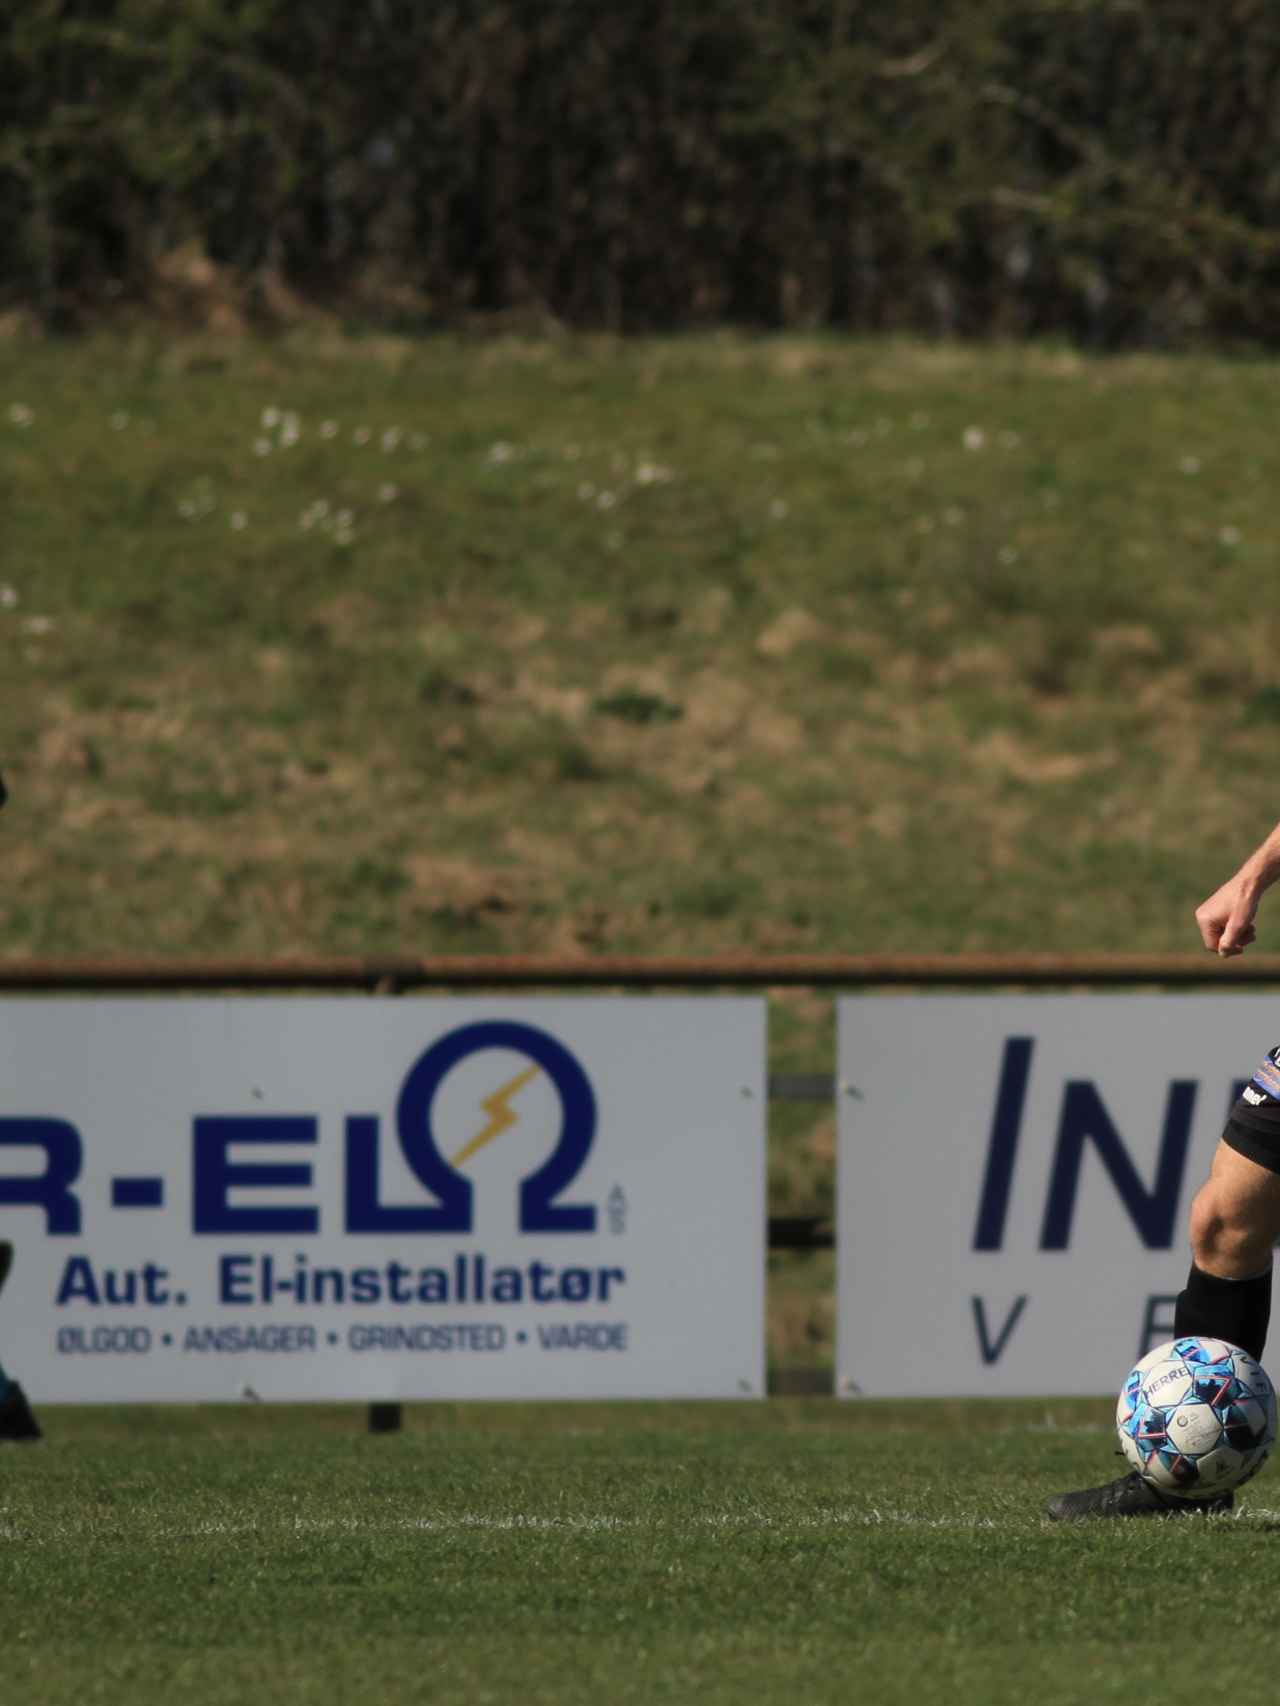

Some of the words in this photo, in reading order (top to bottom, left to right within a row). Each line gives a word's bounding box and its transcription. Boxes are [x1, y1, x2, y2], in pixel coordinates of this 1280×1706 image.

[56, 1257, 186, 1305] Aut.
[219, 1254, 626, 1305] El-installatør
[57, 1325, 151, 1353] ØLGOD
[183, 1325, 316, 1353] ANSAGER
[348, 1325, 505, 1353] GRINDSTED
[538, 1325, 627, 1353] VARDE
